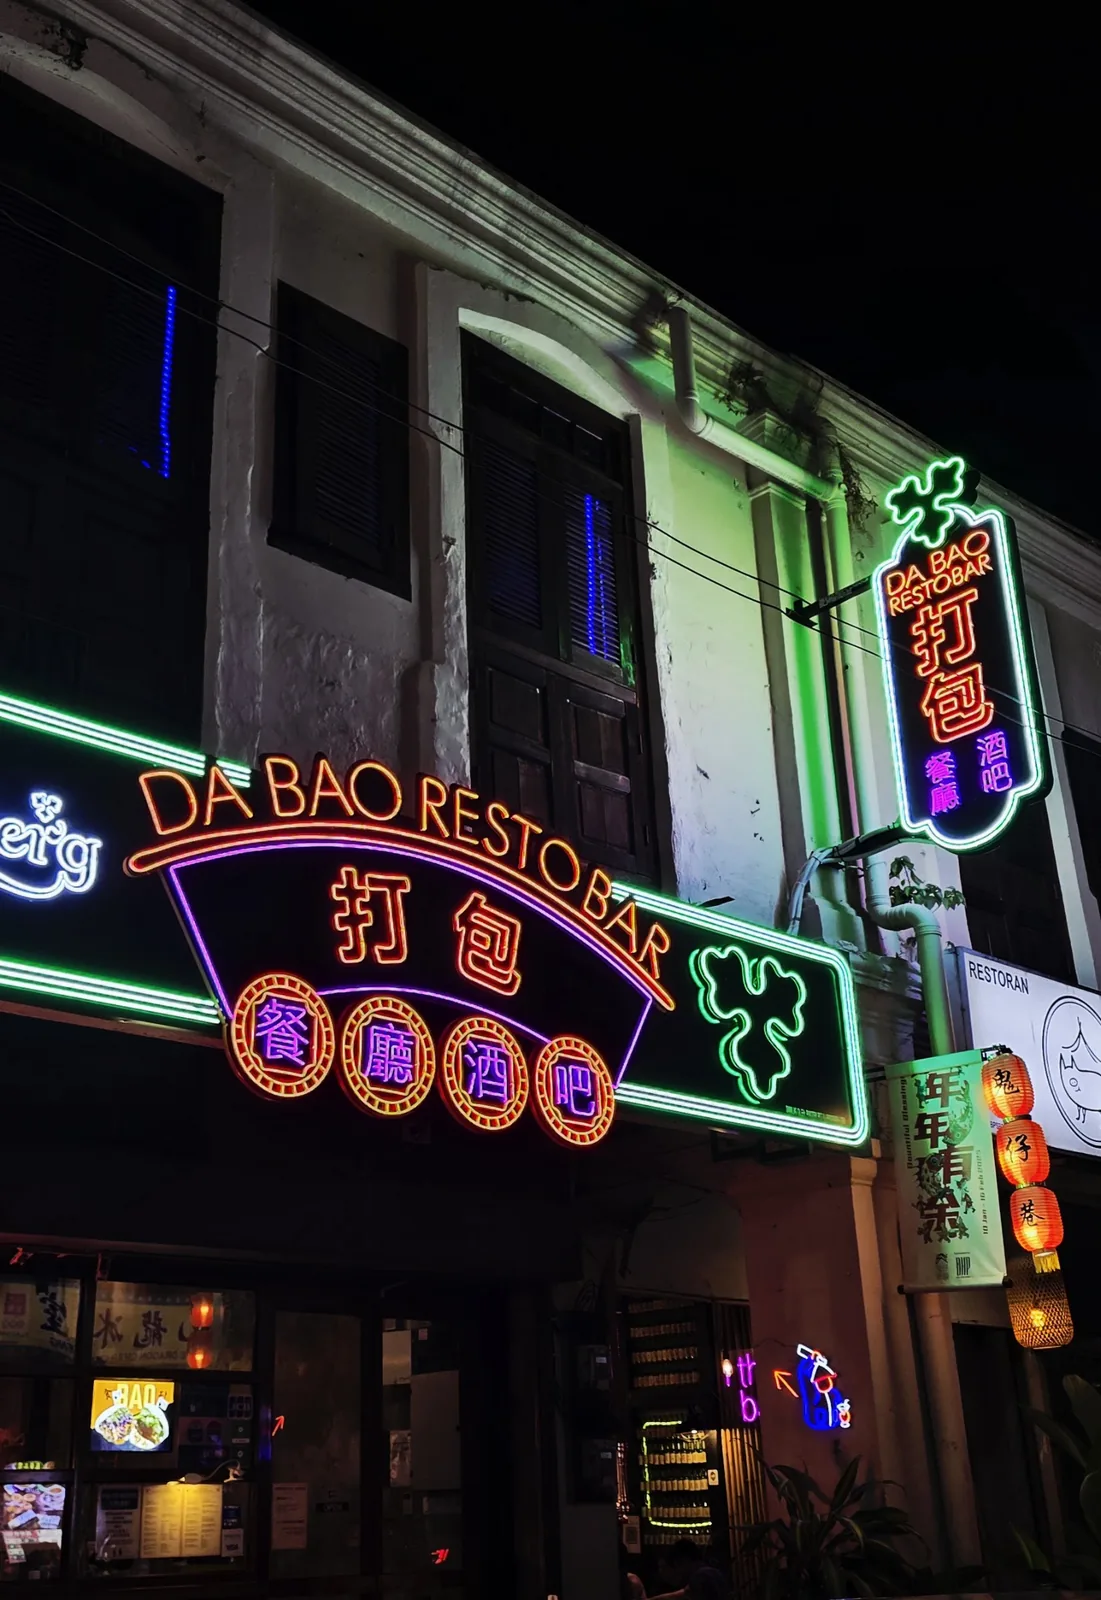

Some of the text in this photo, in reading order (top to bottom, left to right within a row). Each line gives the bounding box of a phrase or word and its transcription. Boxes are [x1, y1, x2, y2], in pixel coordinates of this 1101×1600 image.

[886, 530, 991, 597] DA BAO
[889, 553, 994, 617] RESTOBAR
[911, 587, 996, 744] 打包
[925, 750, 961, 817] 餐廳
[976, 730, 1013, 794] 酒吧
[138, 764, 254, 836] DA
[264, 757, 403, 822] BAO
[331, 865, 523, 997] 打包
[968, 960, 1030, 995] RESTORAN
